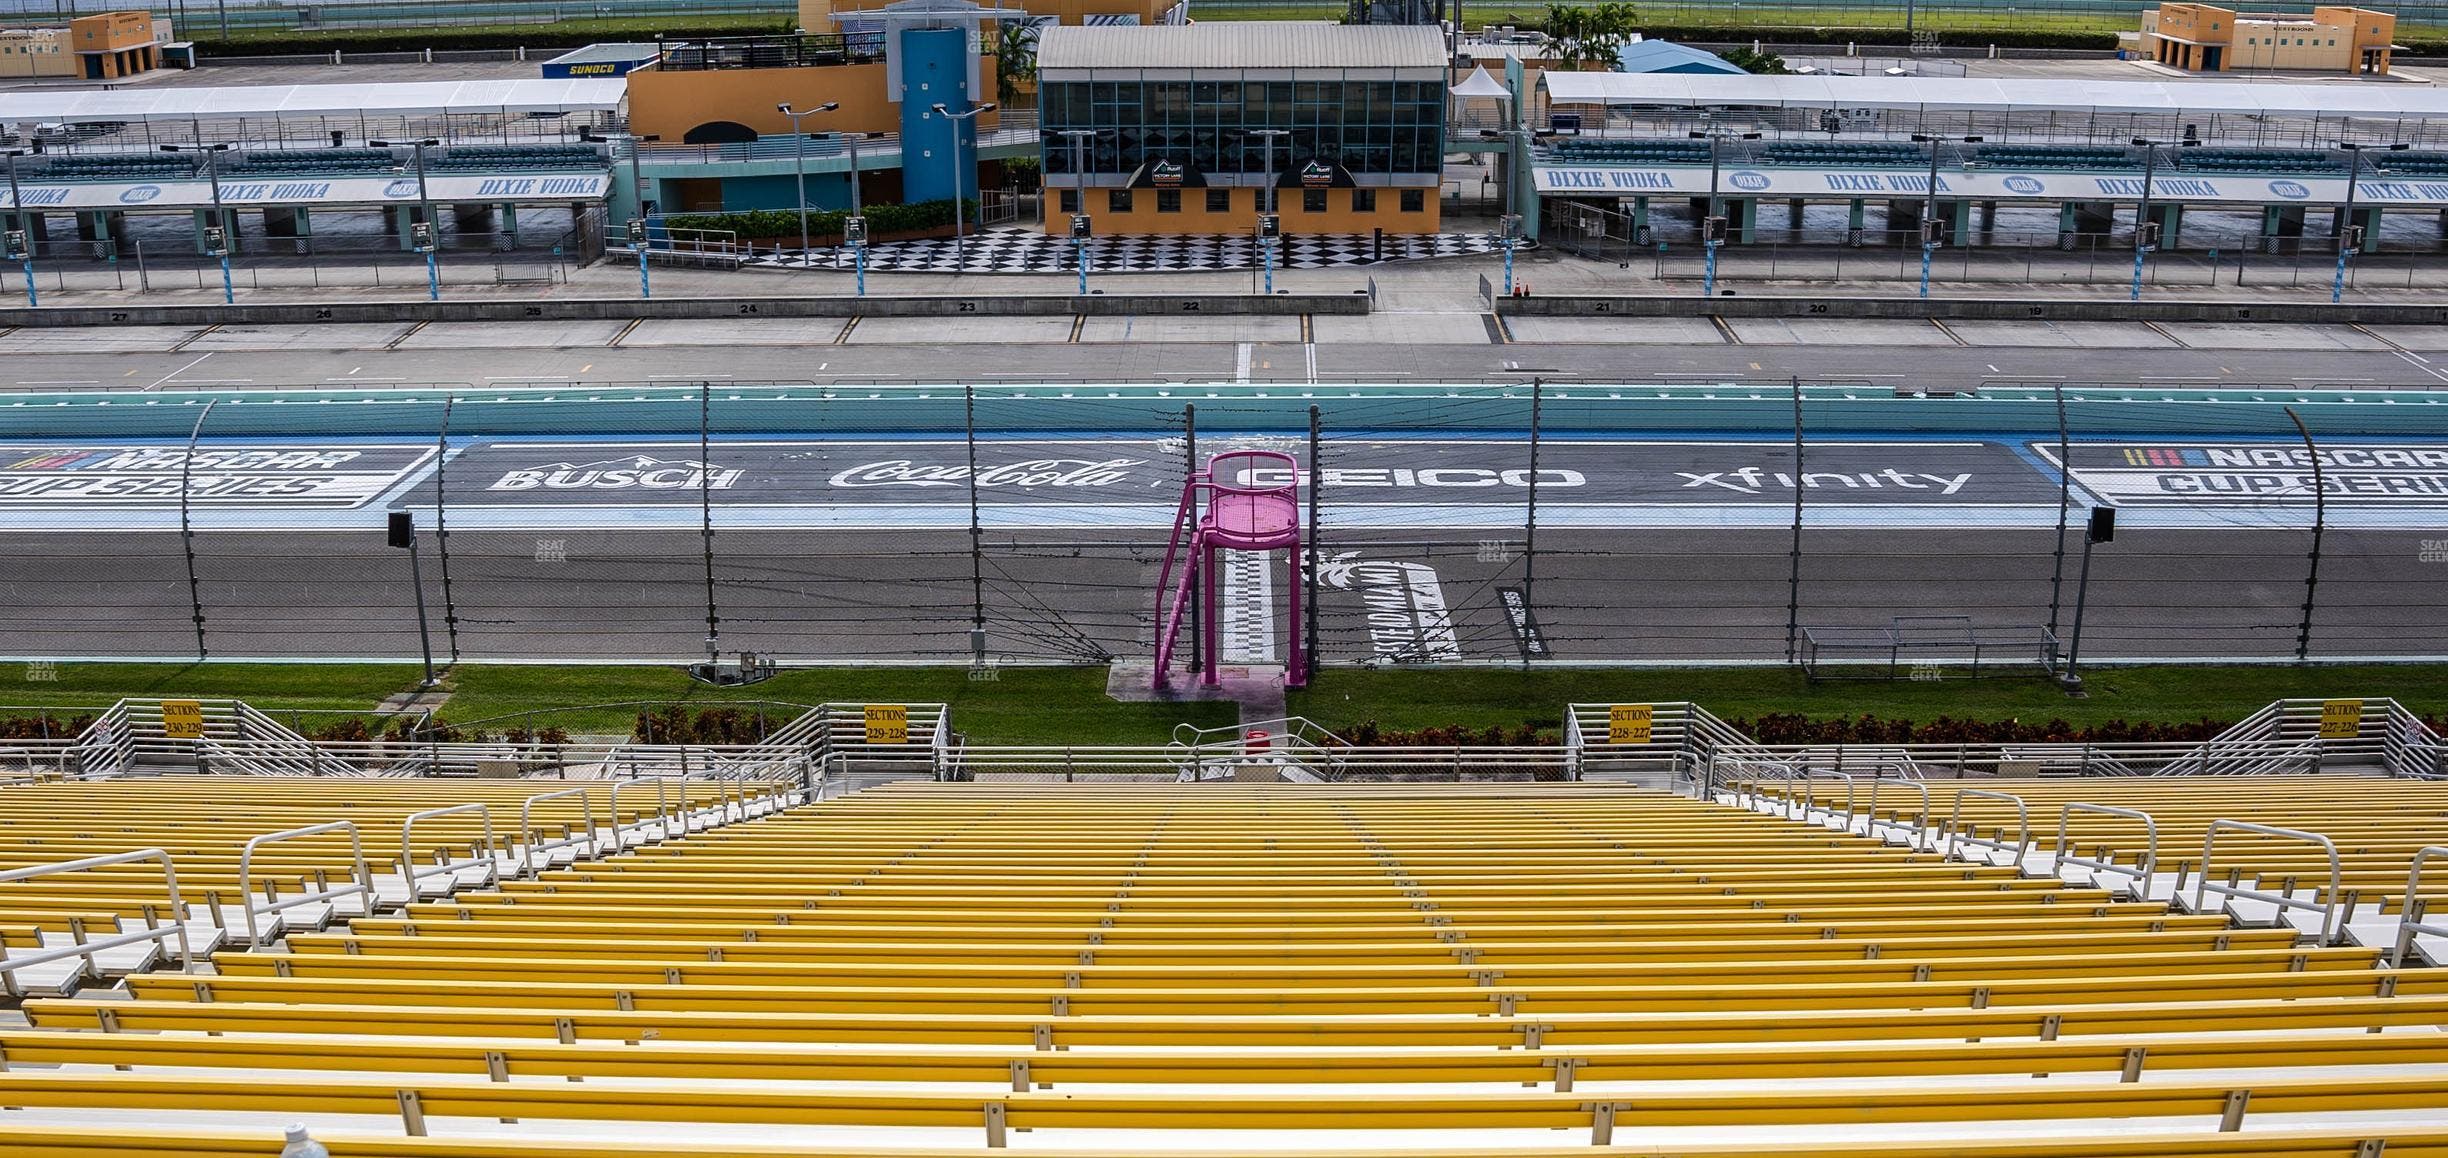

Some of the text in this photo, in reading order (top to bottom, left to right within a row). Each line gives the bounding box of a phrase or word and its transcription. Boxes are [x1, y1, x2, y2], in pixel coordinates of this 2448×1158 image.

[569, 63, 616, 75] SUNOCO
[1545, 171, 1674, 188] DIXIE VODKA
[1735, 175, 1765, 188] DIXIE
[1824, 174, 1884, 191] DIXIE
[2009, 179, 2039, 191] DIXIE
[270, 184, 331, 199] VODKA
[476, 178, 600, 195] DIXIE VODKA
[2153, 179, 2220, 196] VODKA
[2272, 183, 2304, 196] DIXIE
[2357, 183, 2419, 200] DIXIE
[526, 307, 542, 316] 25
[740, 304, 757, 314] 24
[959, 302, 976, 312] 23
[1183, 302, 1199, 311] 22
[1595, 302, 1610, 312] 21
[1809, 304, 1828, 313] 20
[2029, 307, 2042, 315] 19
[111, 313, 128, 322] 27
[316, 310, 332, 319] 26
[2238, 310, 2250, 318] 18
[84, 450, 362, 469] NASCAR
[2205, 448, 2448, 467] NASCAR
[485, 469, 746, 490] BUSCH
[828, 460, 1149, 487] Coca-Cola
[1237, 468, 1586, 487] GEICO
[0, 477, 338, 495] UP SERIES
[1674, 467, 1972, 494] xfinity
[2156, 475, 2448, 494] CUP SERI
[163, 704, 200, 715] SECTIONS
[865, 710, 906, 721] SECTIONS
[1611, 710, 1651, 721] SECTIONS
[2323, 704, 2361, 716] SECTIONS
[166, 722, 202, 733] 230-229
[2320, 722, 2358, 732] 227-226
[867, 728, 907, 739] 229-228
[1611, 728, 1651, 739] 228-227
